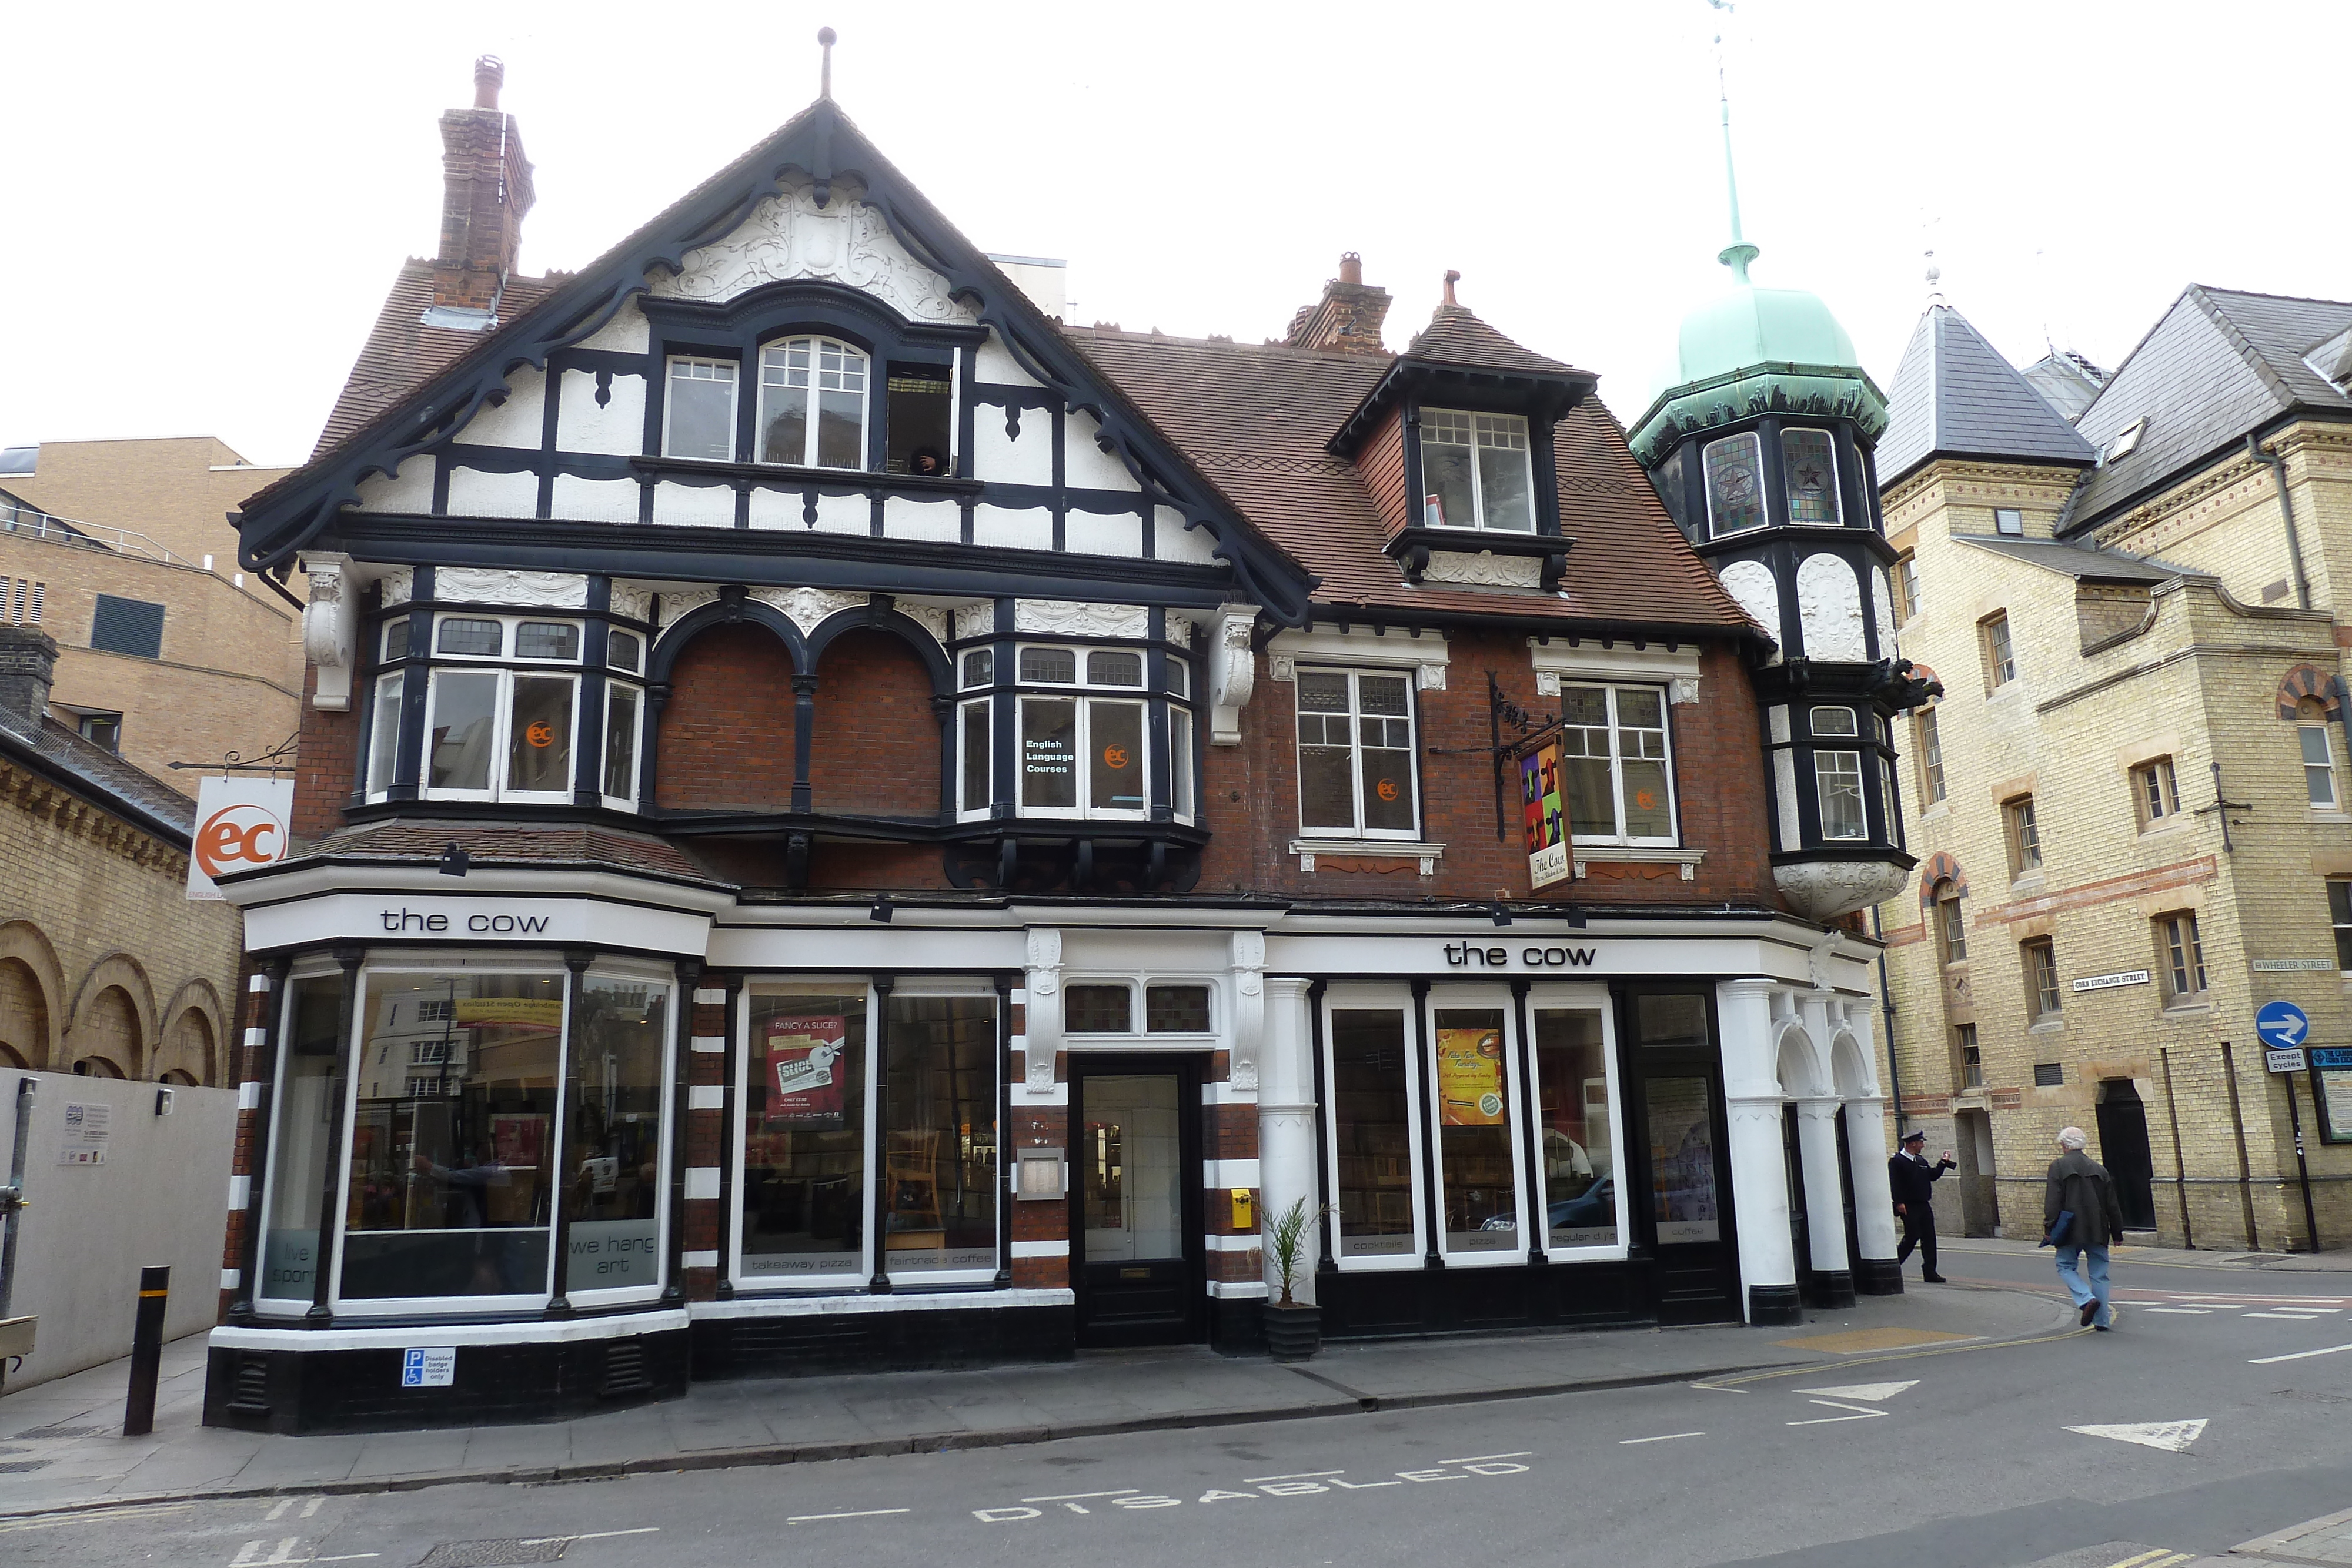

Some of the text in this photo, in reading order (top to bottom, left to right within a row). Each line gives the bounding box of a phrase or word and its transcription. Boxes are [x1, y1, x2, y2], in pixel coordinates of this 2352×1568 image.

[1026, 740, 1062, 749] English
[1026, 753, 1074, 762] Language
[1027, 765, 1067, 773] Courses
[206, 821, 276, 864] ec
[1534, 857, 1548, 875] The
[380, 907, 550, 932] the cow
[1443, 941, 1596, 966] the cow
[2262, 961, 2331, 969] WHEELER STREET
[2091, 976, 2120, 987] EXCHANGE
[2122, 973, 2145, 982] STREET
[2270, 1052, 2301, 1069] Except cycles
[782, 1059, 812, 1078] SLICE
[570, 1236, 655, 1254] we hang
[1354, 1241, 1404, 1250] cocktails
[1469, 1237, 1496, 1246] pizza
[1551, 1233, 1590, 1243] regular
[285, 1242, 309, 1261] live
[597, 1258, 629, 1274] art
[752, 1258, 852, 1271] takeaway pizza
[890, 1253, 992, 1266] fairtrade coffee
[410, 1351, 422, 1366] P
[971, 1462, 1530, 1523] DISABLED
